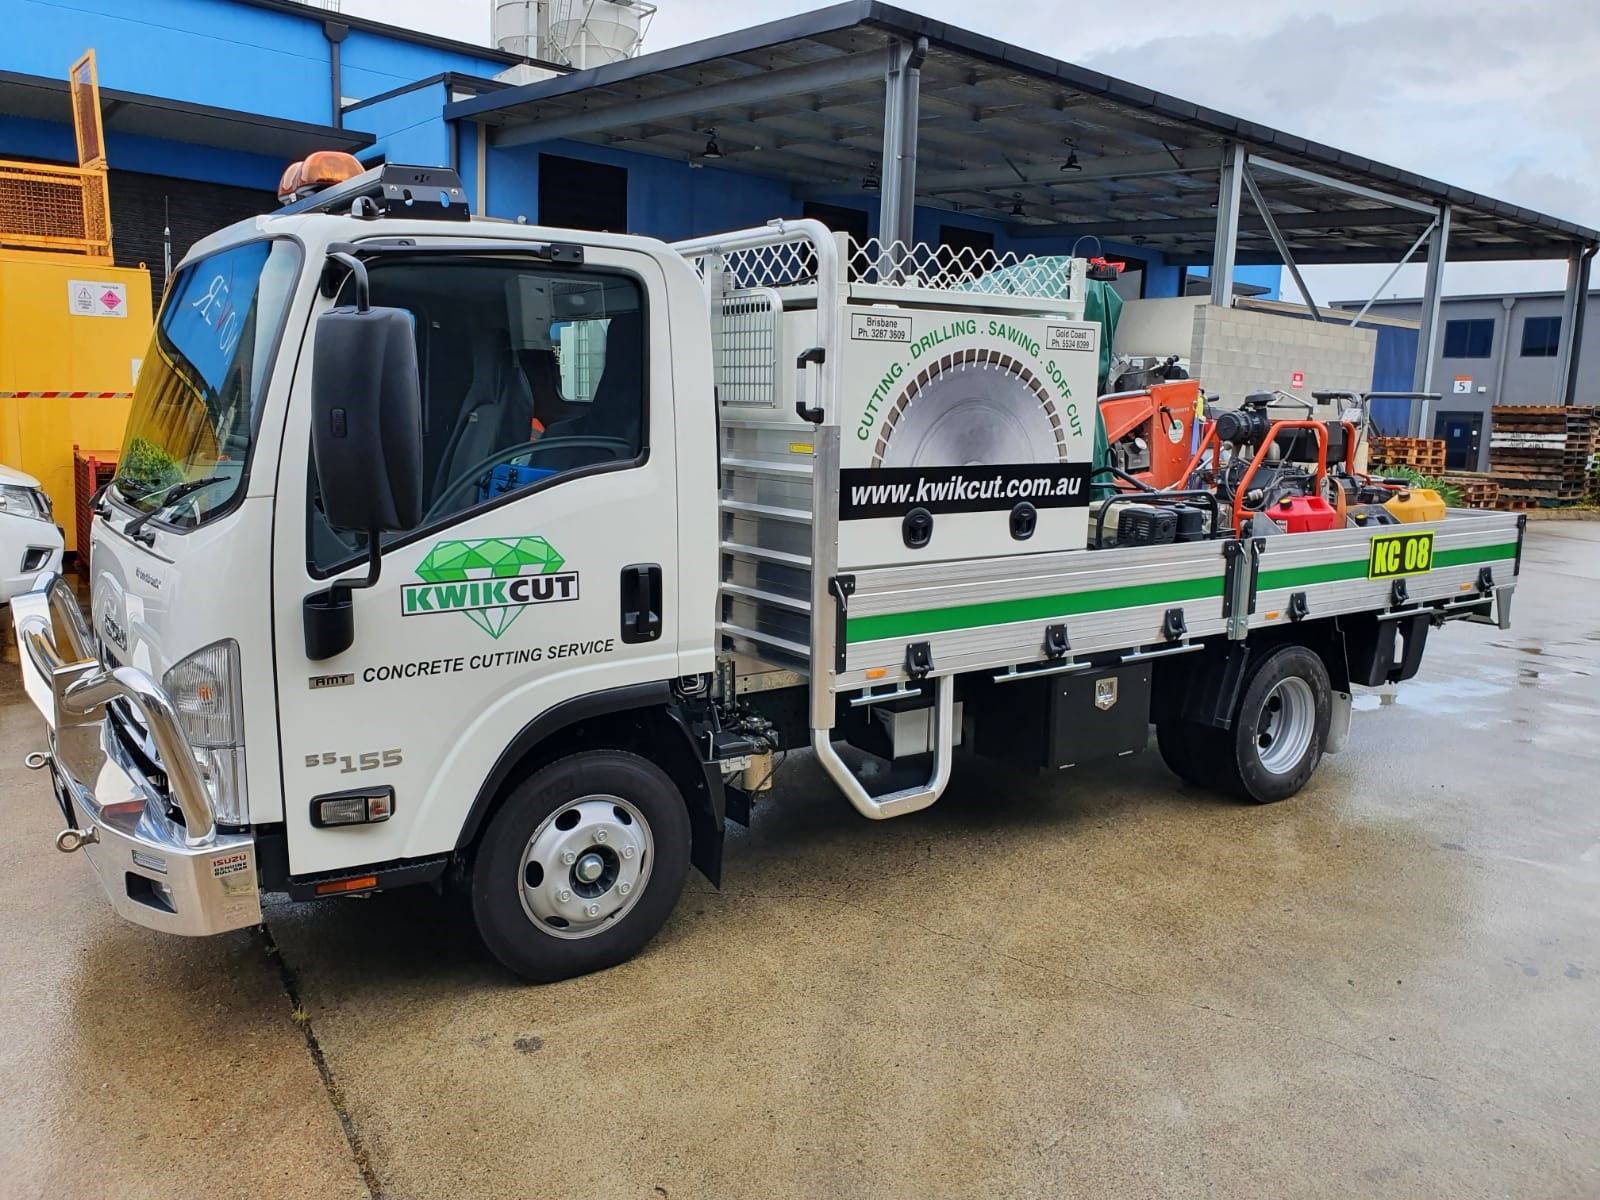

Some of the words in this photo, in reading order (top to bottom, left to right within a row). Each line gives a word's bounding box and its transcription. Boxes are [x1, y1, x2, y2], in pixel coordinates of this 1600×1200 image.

[866, 317, 898, 328] Brisbane
[857, 327, 869, 338] Ph.
[871, 328, 888, 338] 3287
[1055, 329, 1070, 338] Gold
[1070, 330, 1087, 340] Coast
[857, 362, 903, 441] CUTTING
[910, 319, 976, 359] DRILLING
[988, 320, 1040, 358] SAWING
[1045, 360, 1072, 400] SOFF
[1067, 404, 1083, 437] CUT
[1459, 381, 1466, 392] 5
[851, 475, 1082, 506] www.kwikcut.com.au
[1374, 540, 1401, 574] KC
[1404, 537, 1430, 570] 08
[406, 575, 576, 612] KWIKCUT
[362, 657, 465, 683] CONCRETE
[469, 647, 543, 670] CUTTING
[547, 638, 615, 660] SERVICE
[315, 674, 349, 687] AMT
[213, 854, 247, 867] ISUZU
